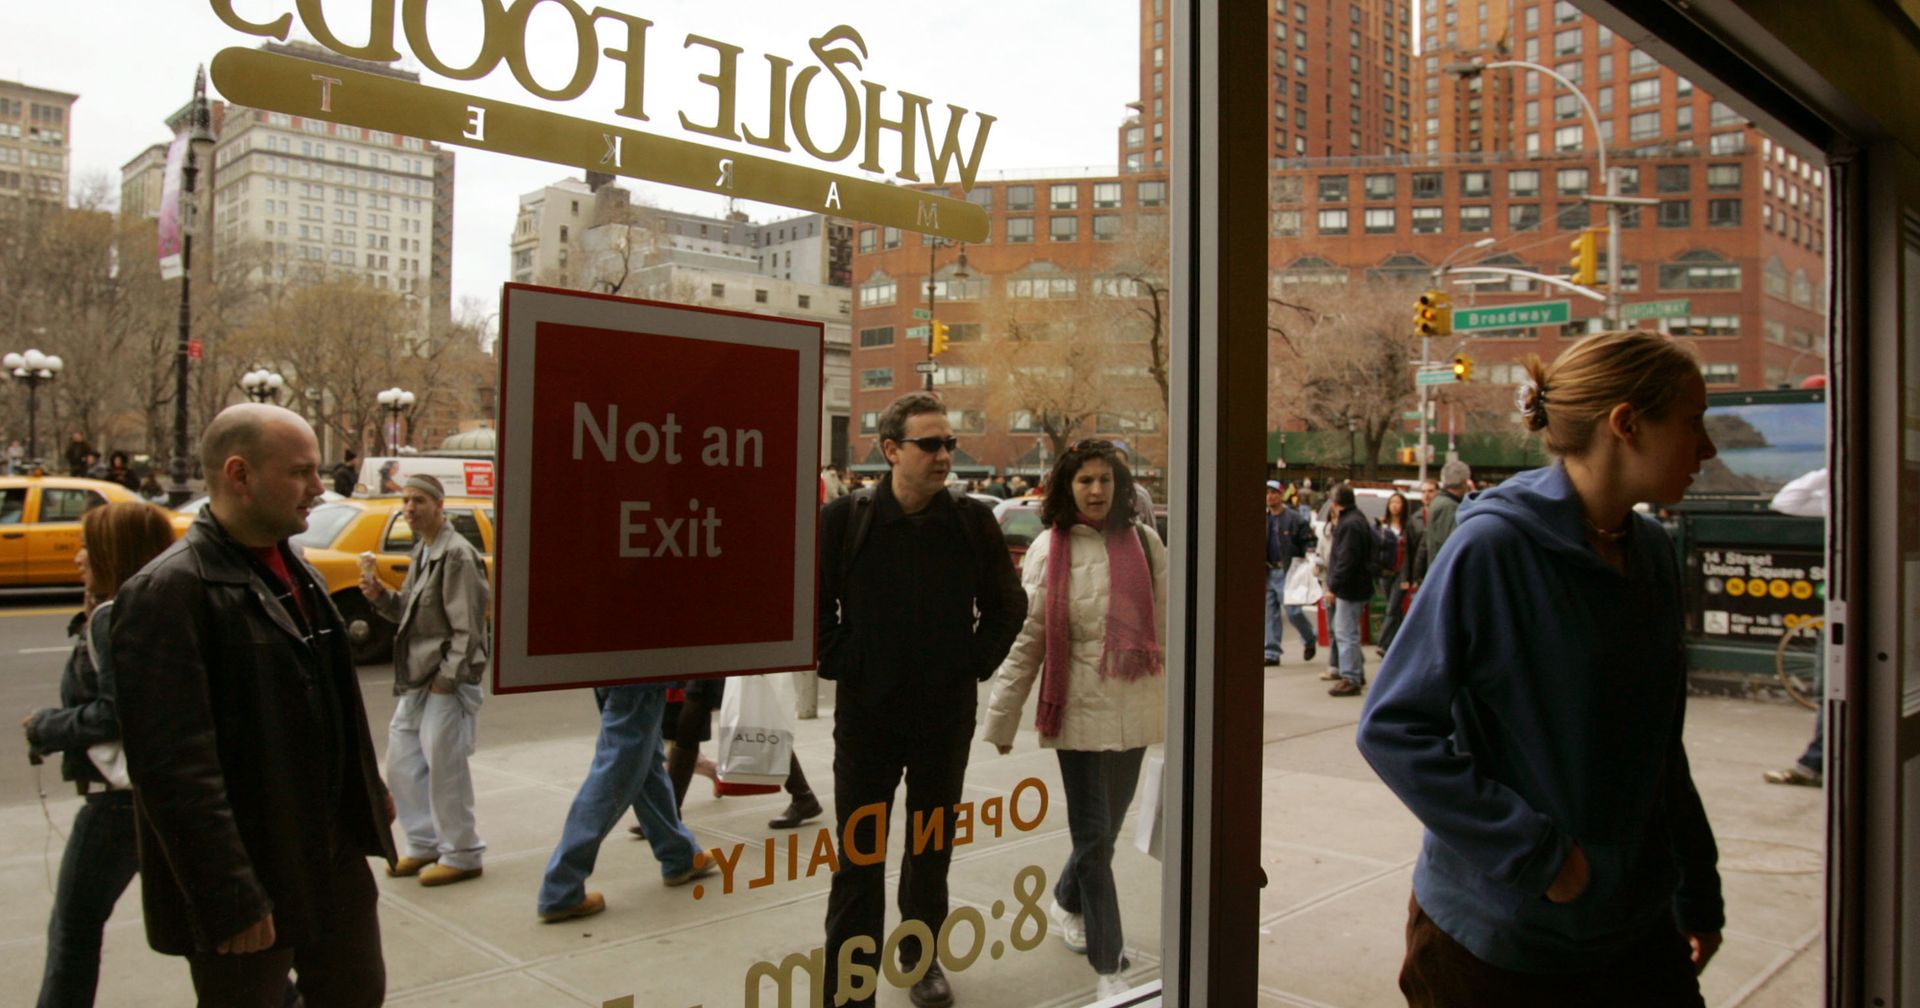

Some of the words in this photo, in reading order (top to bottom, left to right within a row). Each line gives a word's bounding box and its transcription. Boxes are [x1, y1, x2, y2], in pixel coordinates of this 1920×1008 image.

[1469, 309, 1551, 326] Broadway
[572, 401, 683, 465] Not
[701, 426, 764, 468] an
[619, 498, 723, 558] Exit
[1703, 551, 1720, 564] 14
[1725, 551, 1772, 566] Street
[1703, 563, 1745, 576] Union
[1749, 564, 1805, 580] Square
[735, 732, 780, 745] ALDO
